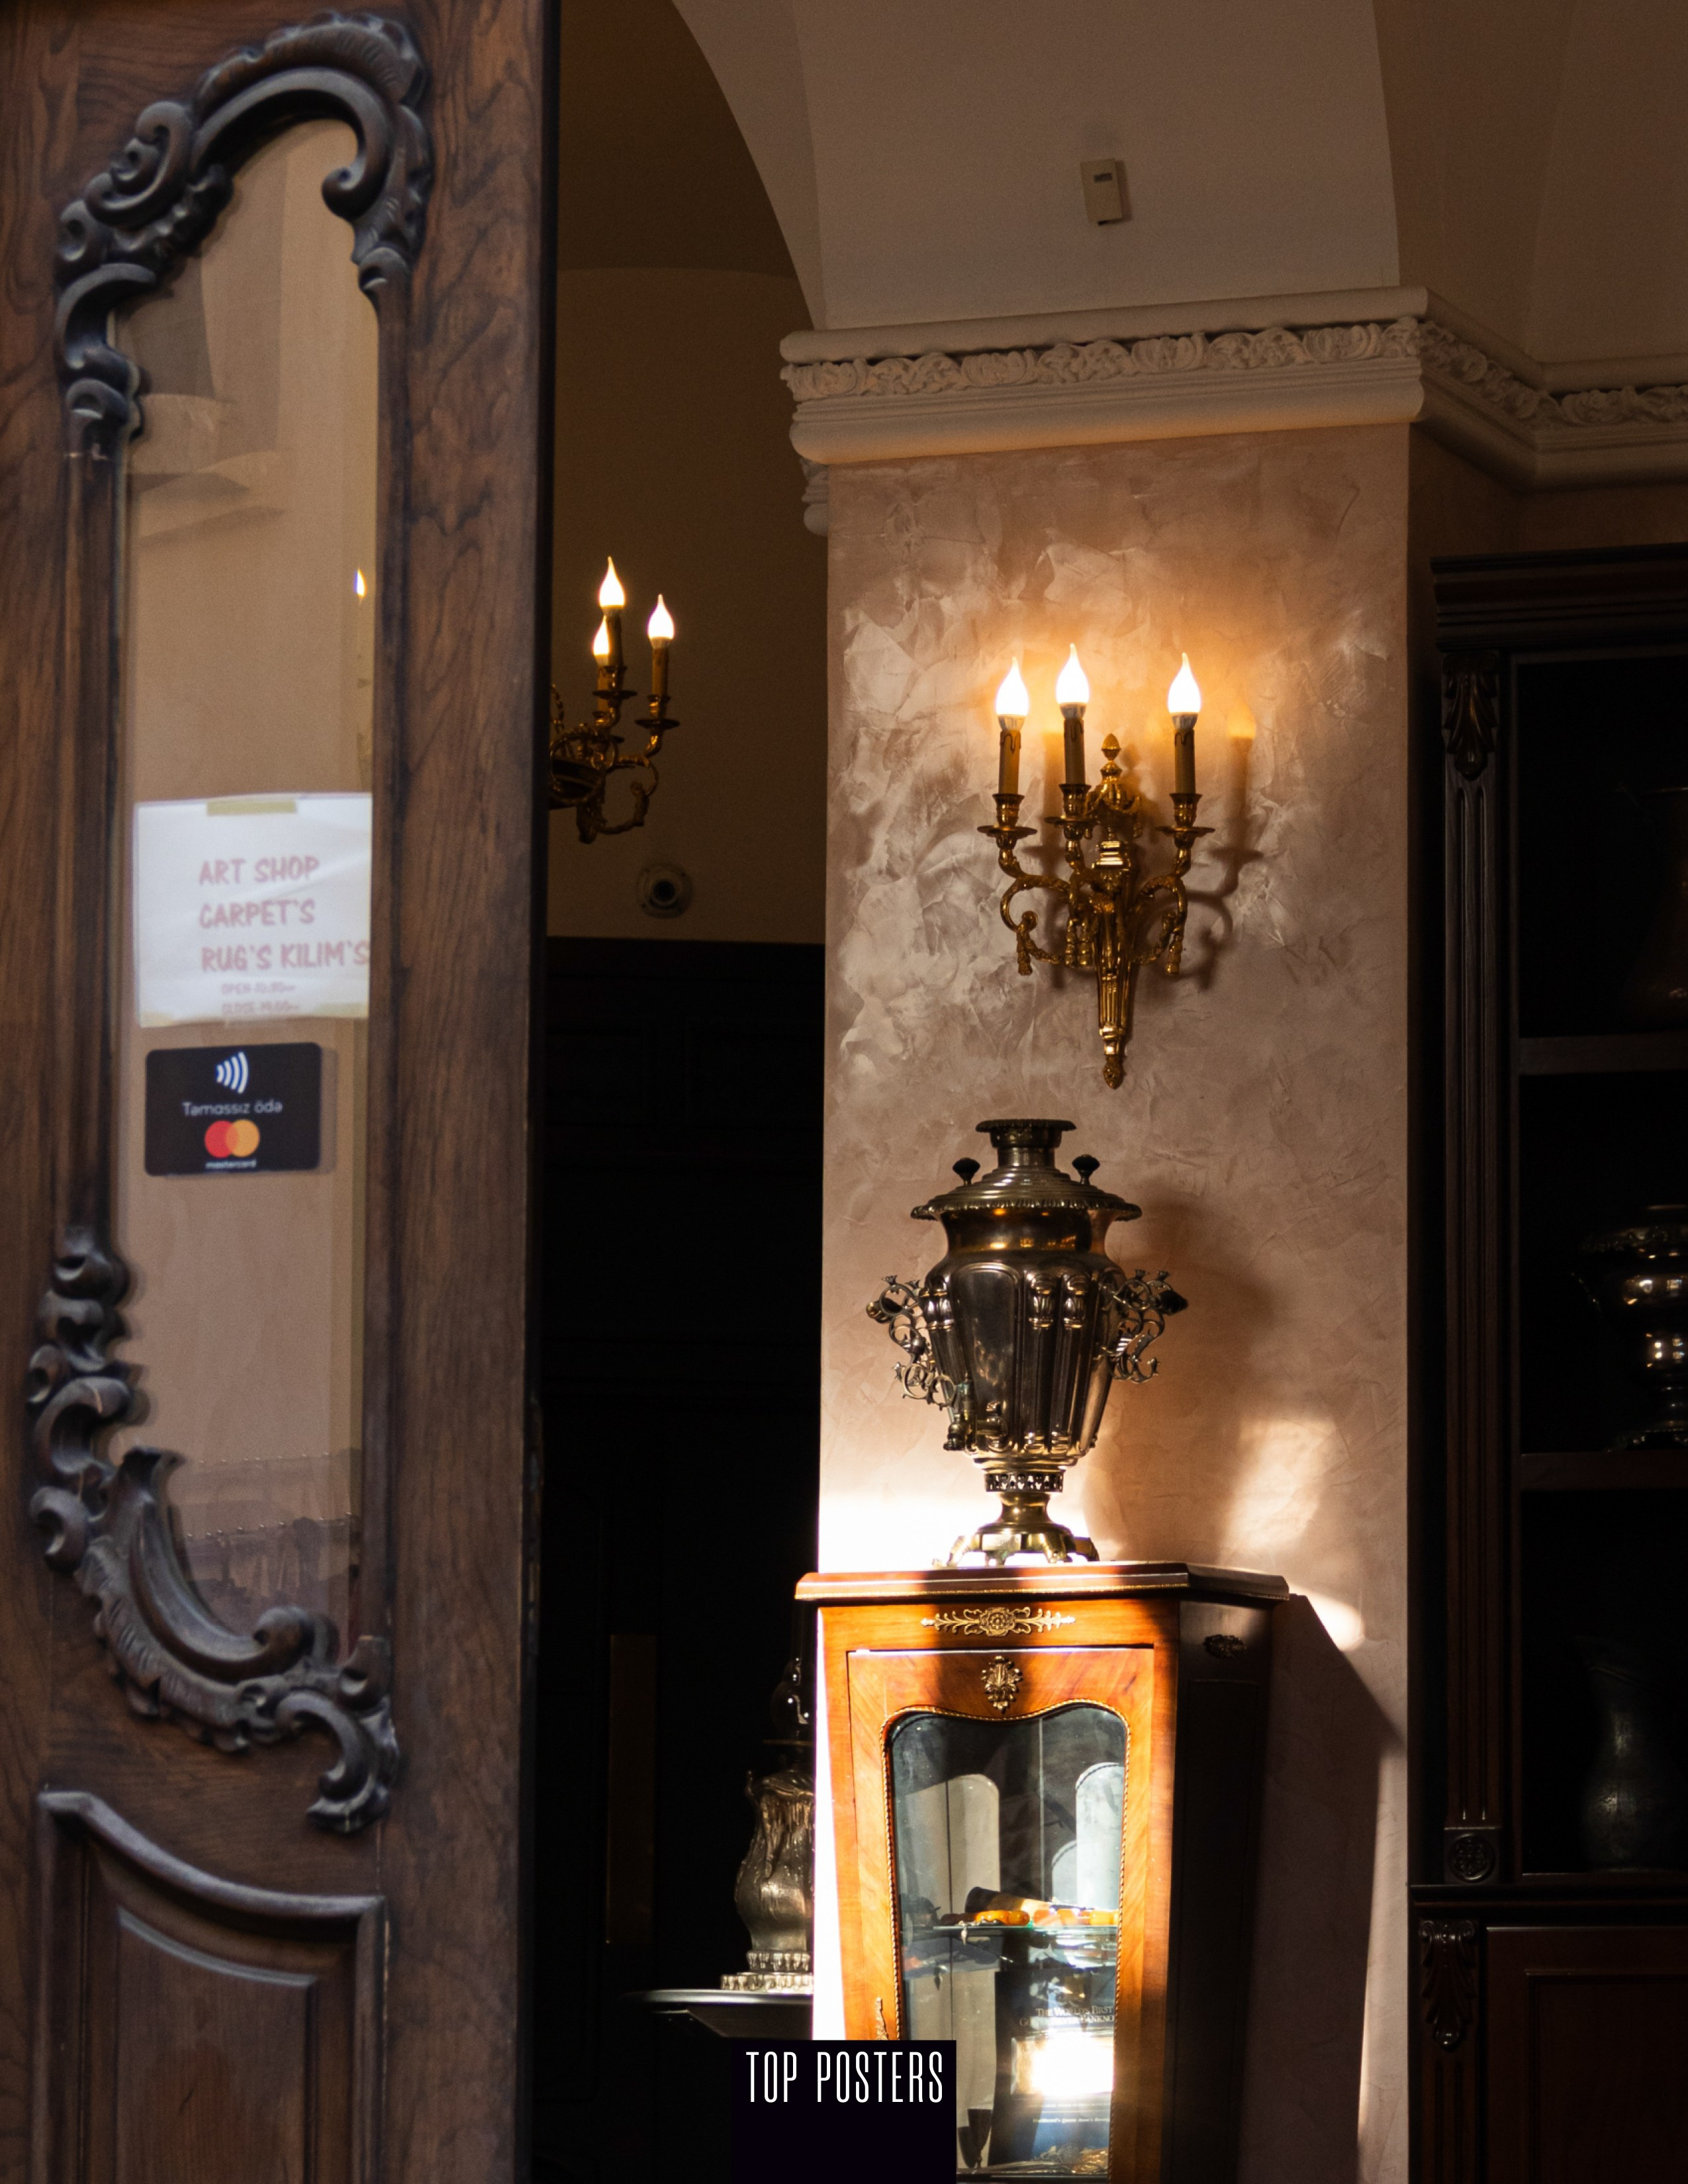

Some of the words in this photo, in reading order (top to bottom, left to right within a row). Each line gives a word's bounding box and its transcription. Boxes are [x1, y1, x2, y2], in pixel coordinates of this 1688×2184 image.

[199, 858, 247, 885] ART
[254, 856, 320, 882] SHOP
[199, 898, 316, 928] CARPET'S
[201, 944, 271, 972] RUG'S
[1092, 2005, 1113, 2014] FIRST
